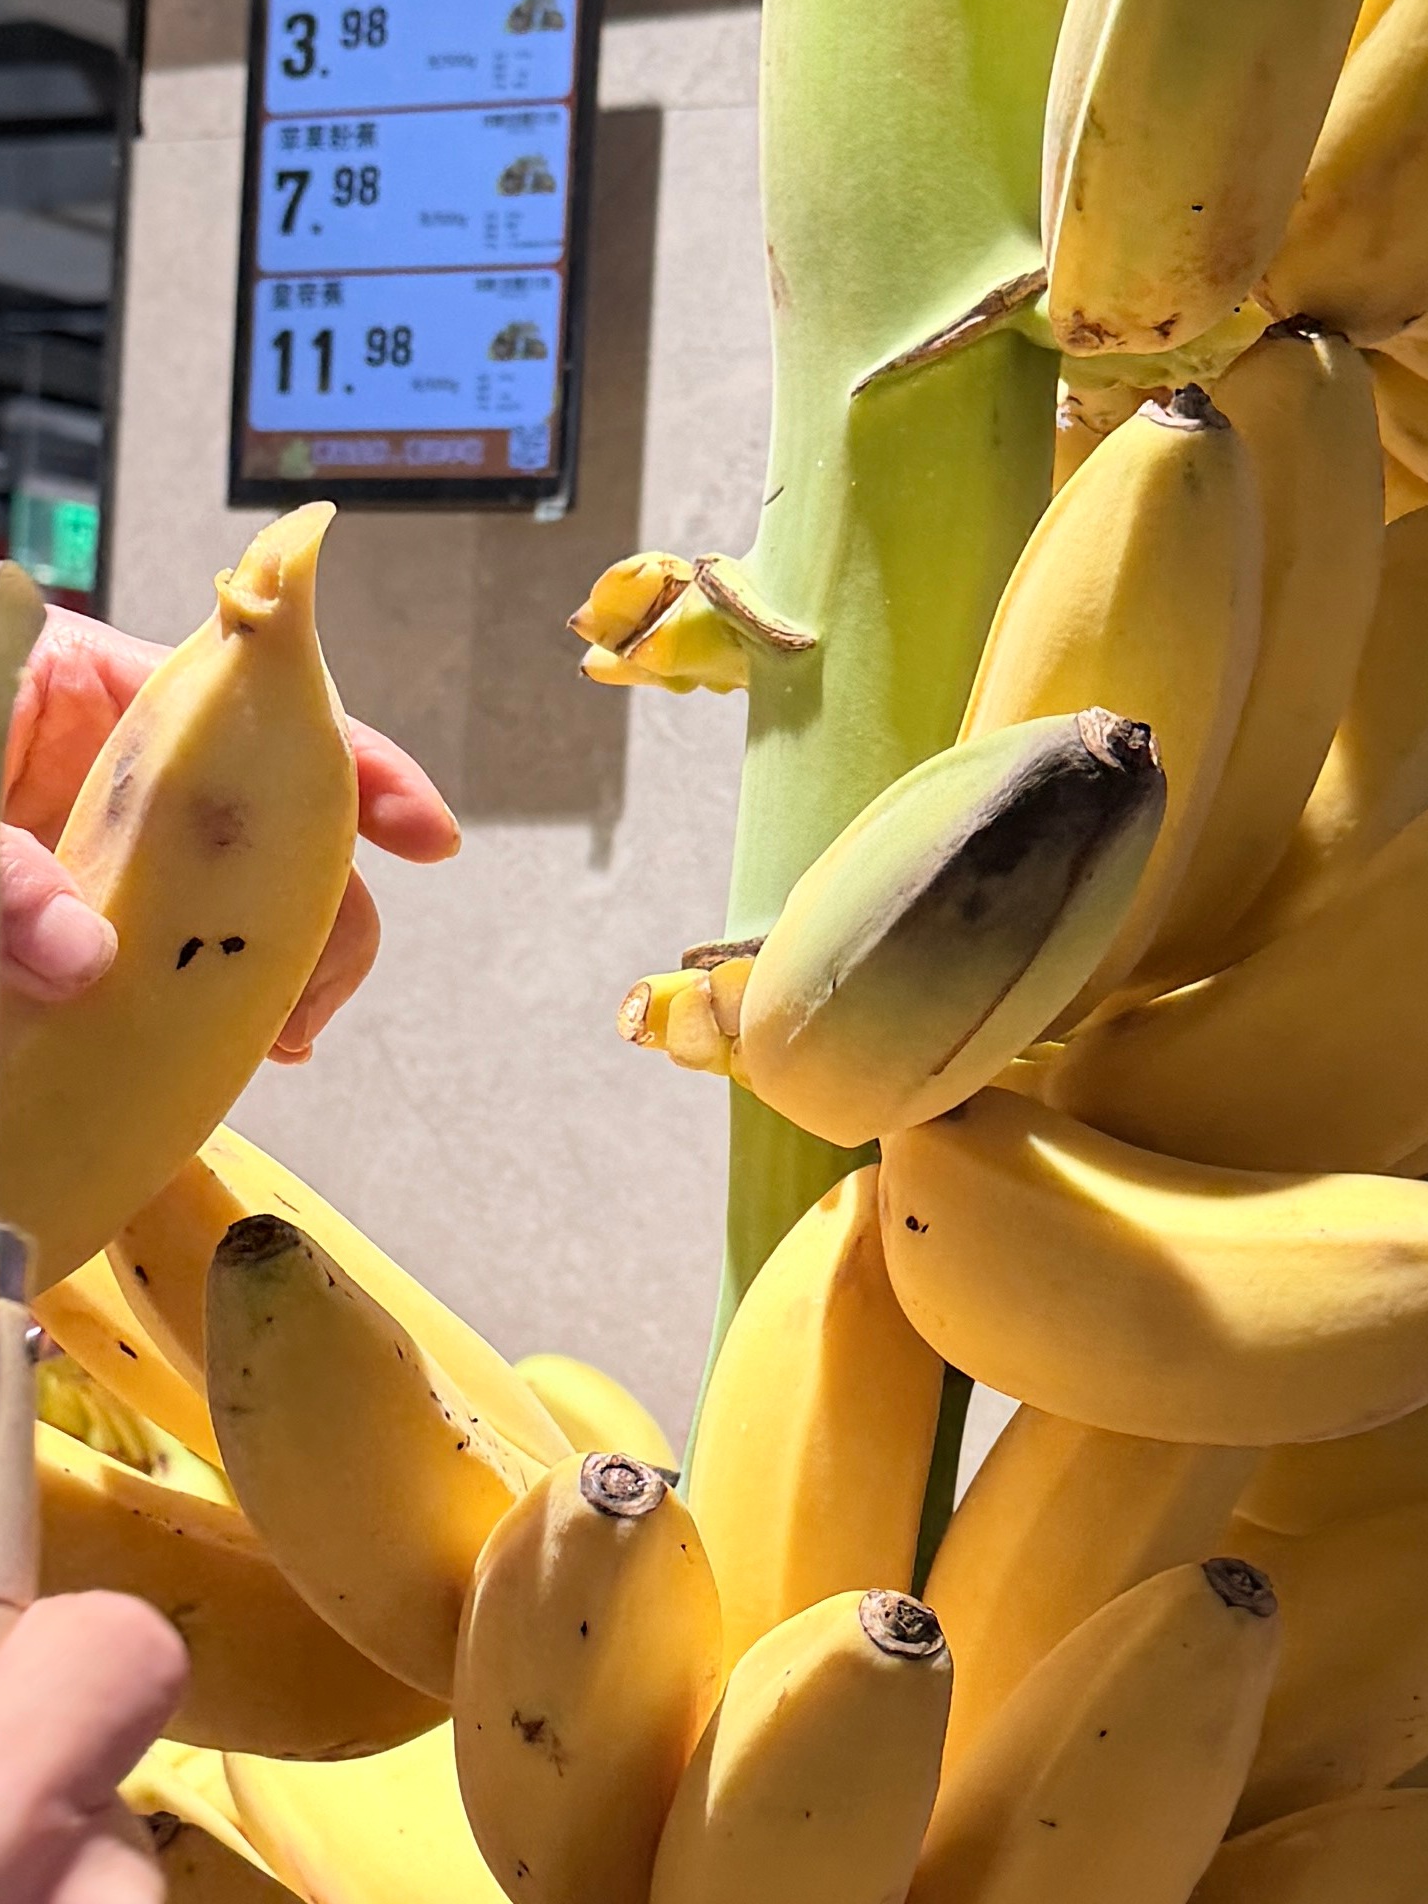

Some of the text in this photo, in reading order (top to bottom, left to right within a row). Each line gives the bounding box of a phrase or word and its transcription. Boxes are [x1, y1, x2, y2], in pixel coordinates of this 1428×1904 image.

[340, 6, 389, 49] 98
[332, 165, 381, 207] 98
[365, 325, 413, 366] 98
